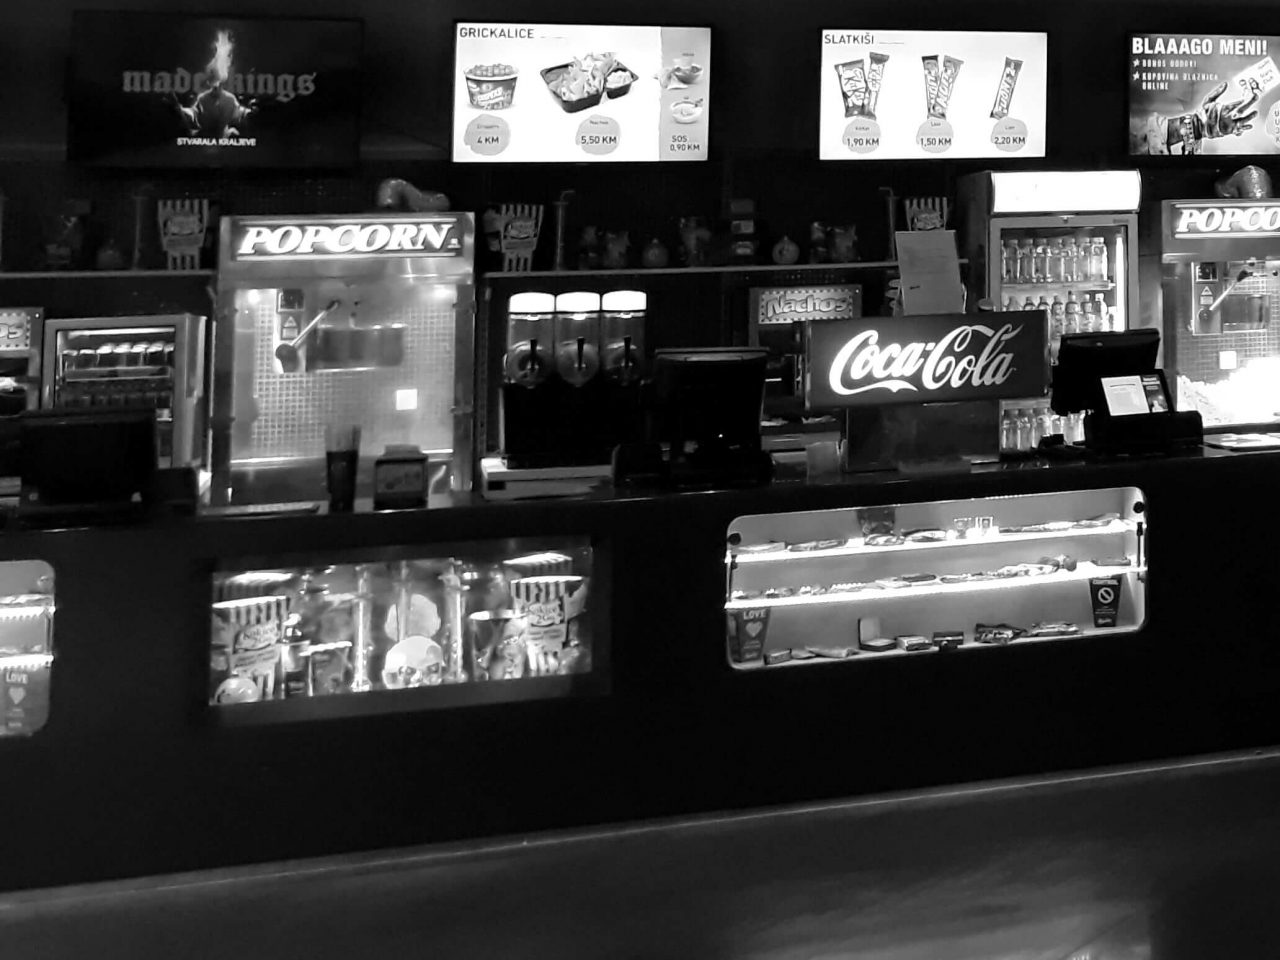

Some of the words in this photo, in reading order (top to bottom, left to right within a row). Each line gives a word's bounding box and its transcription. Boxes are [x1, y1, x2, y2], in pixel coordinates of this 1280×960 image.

[459, 28, 535, 40] GRICKALICE
[824, 31, 875, 45] SLATKIŠI
[1132, 37, 1213, 55] BLAAAGO
[1220, 39, 1267, 55] MENI!
[485, 136, 500, 144] KM
[602, 136, 617, 144] KM
[846, 138, 864, 148] 1,90
[865, 138, 879, 147] KM
[920, 138, 936, 148] 1,50
[937, 138, 952, 147] KM
[1011, 136, 1026, 145] KM
[688, 143, 700, 151] KM
[239, 224, 454, 254] POPCORN
[766, 293, 848, 319] Nachos
[829, 322, 1024, 396] Coca-Cola
[744, 609, 767, 620] LOVE
[6, 671, 28, 685] LOVE
